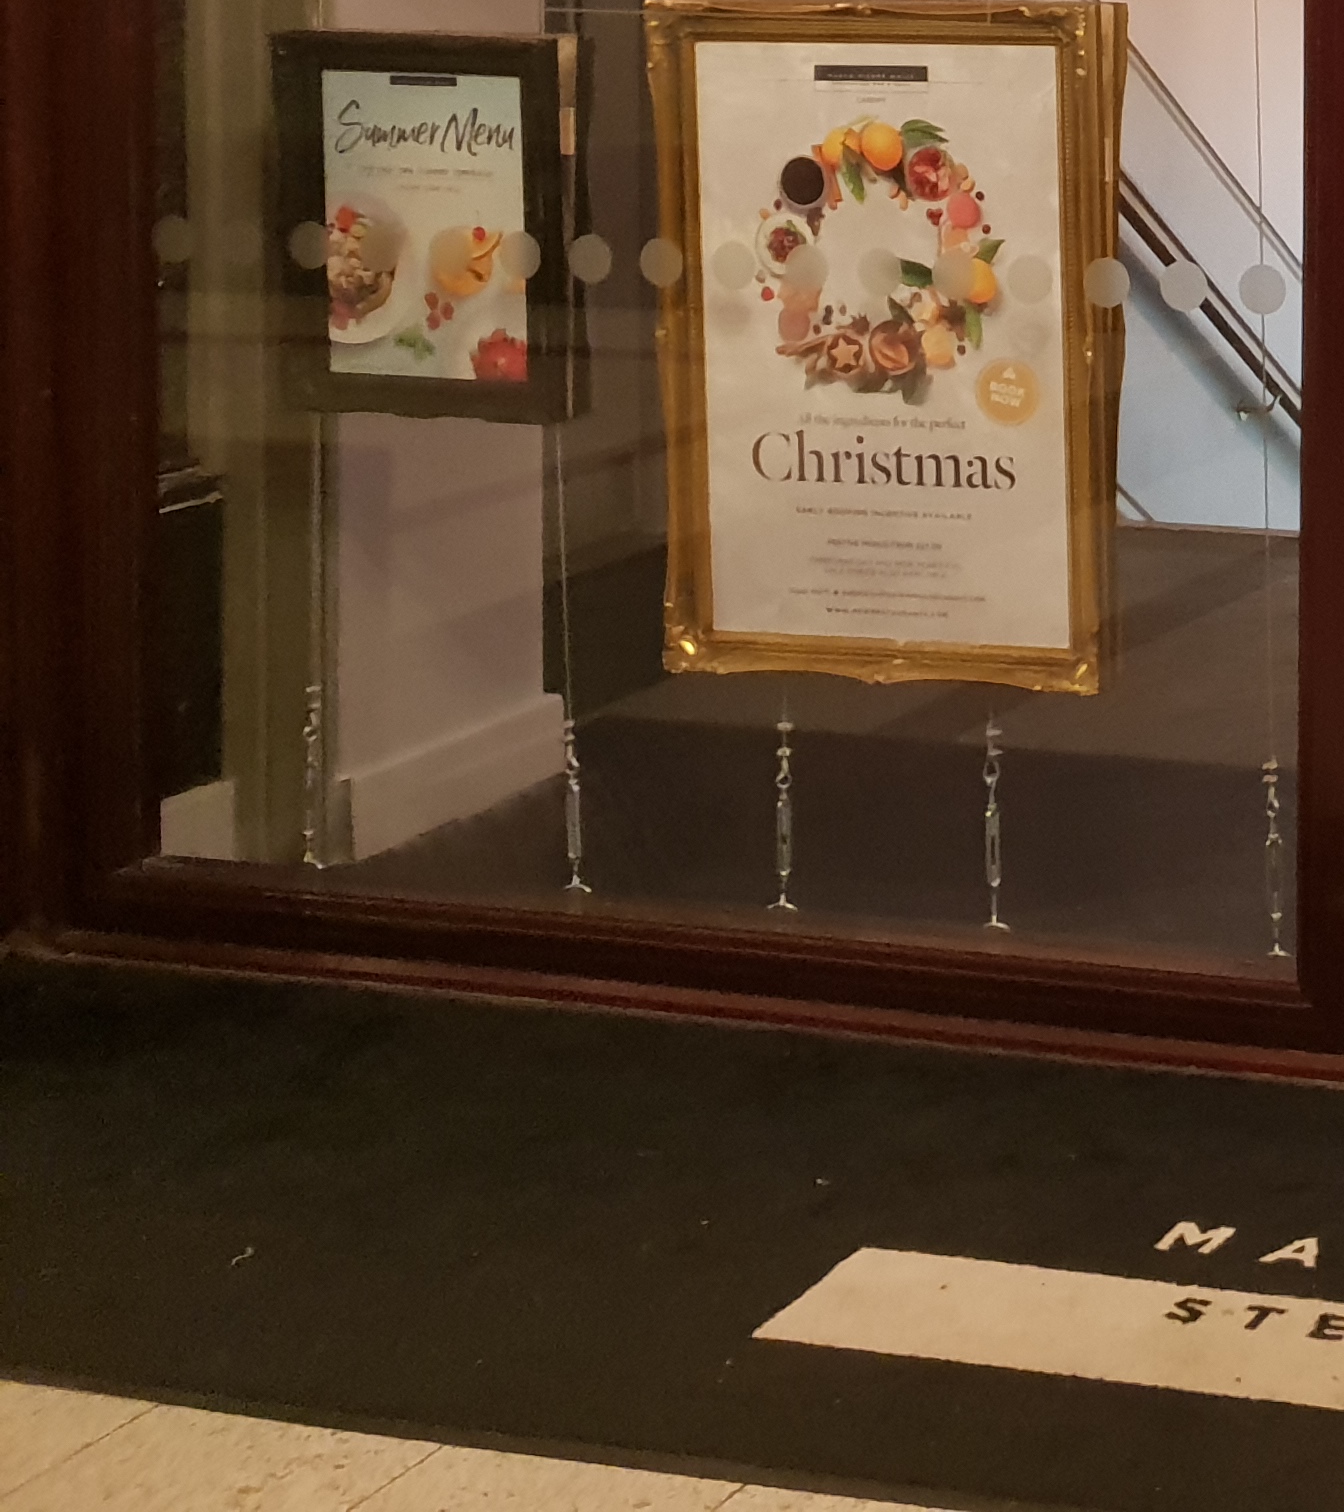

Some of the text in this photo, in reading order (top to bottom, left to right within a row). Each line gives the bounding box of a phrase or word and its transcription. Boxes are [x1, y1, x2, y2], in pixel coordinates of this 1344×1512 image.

[334, 99, 516, 157] Summer Menu
[929, 416, 966, 432] perfect
[751, 428, 1017, 491] Christmas
